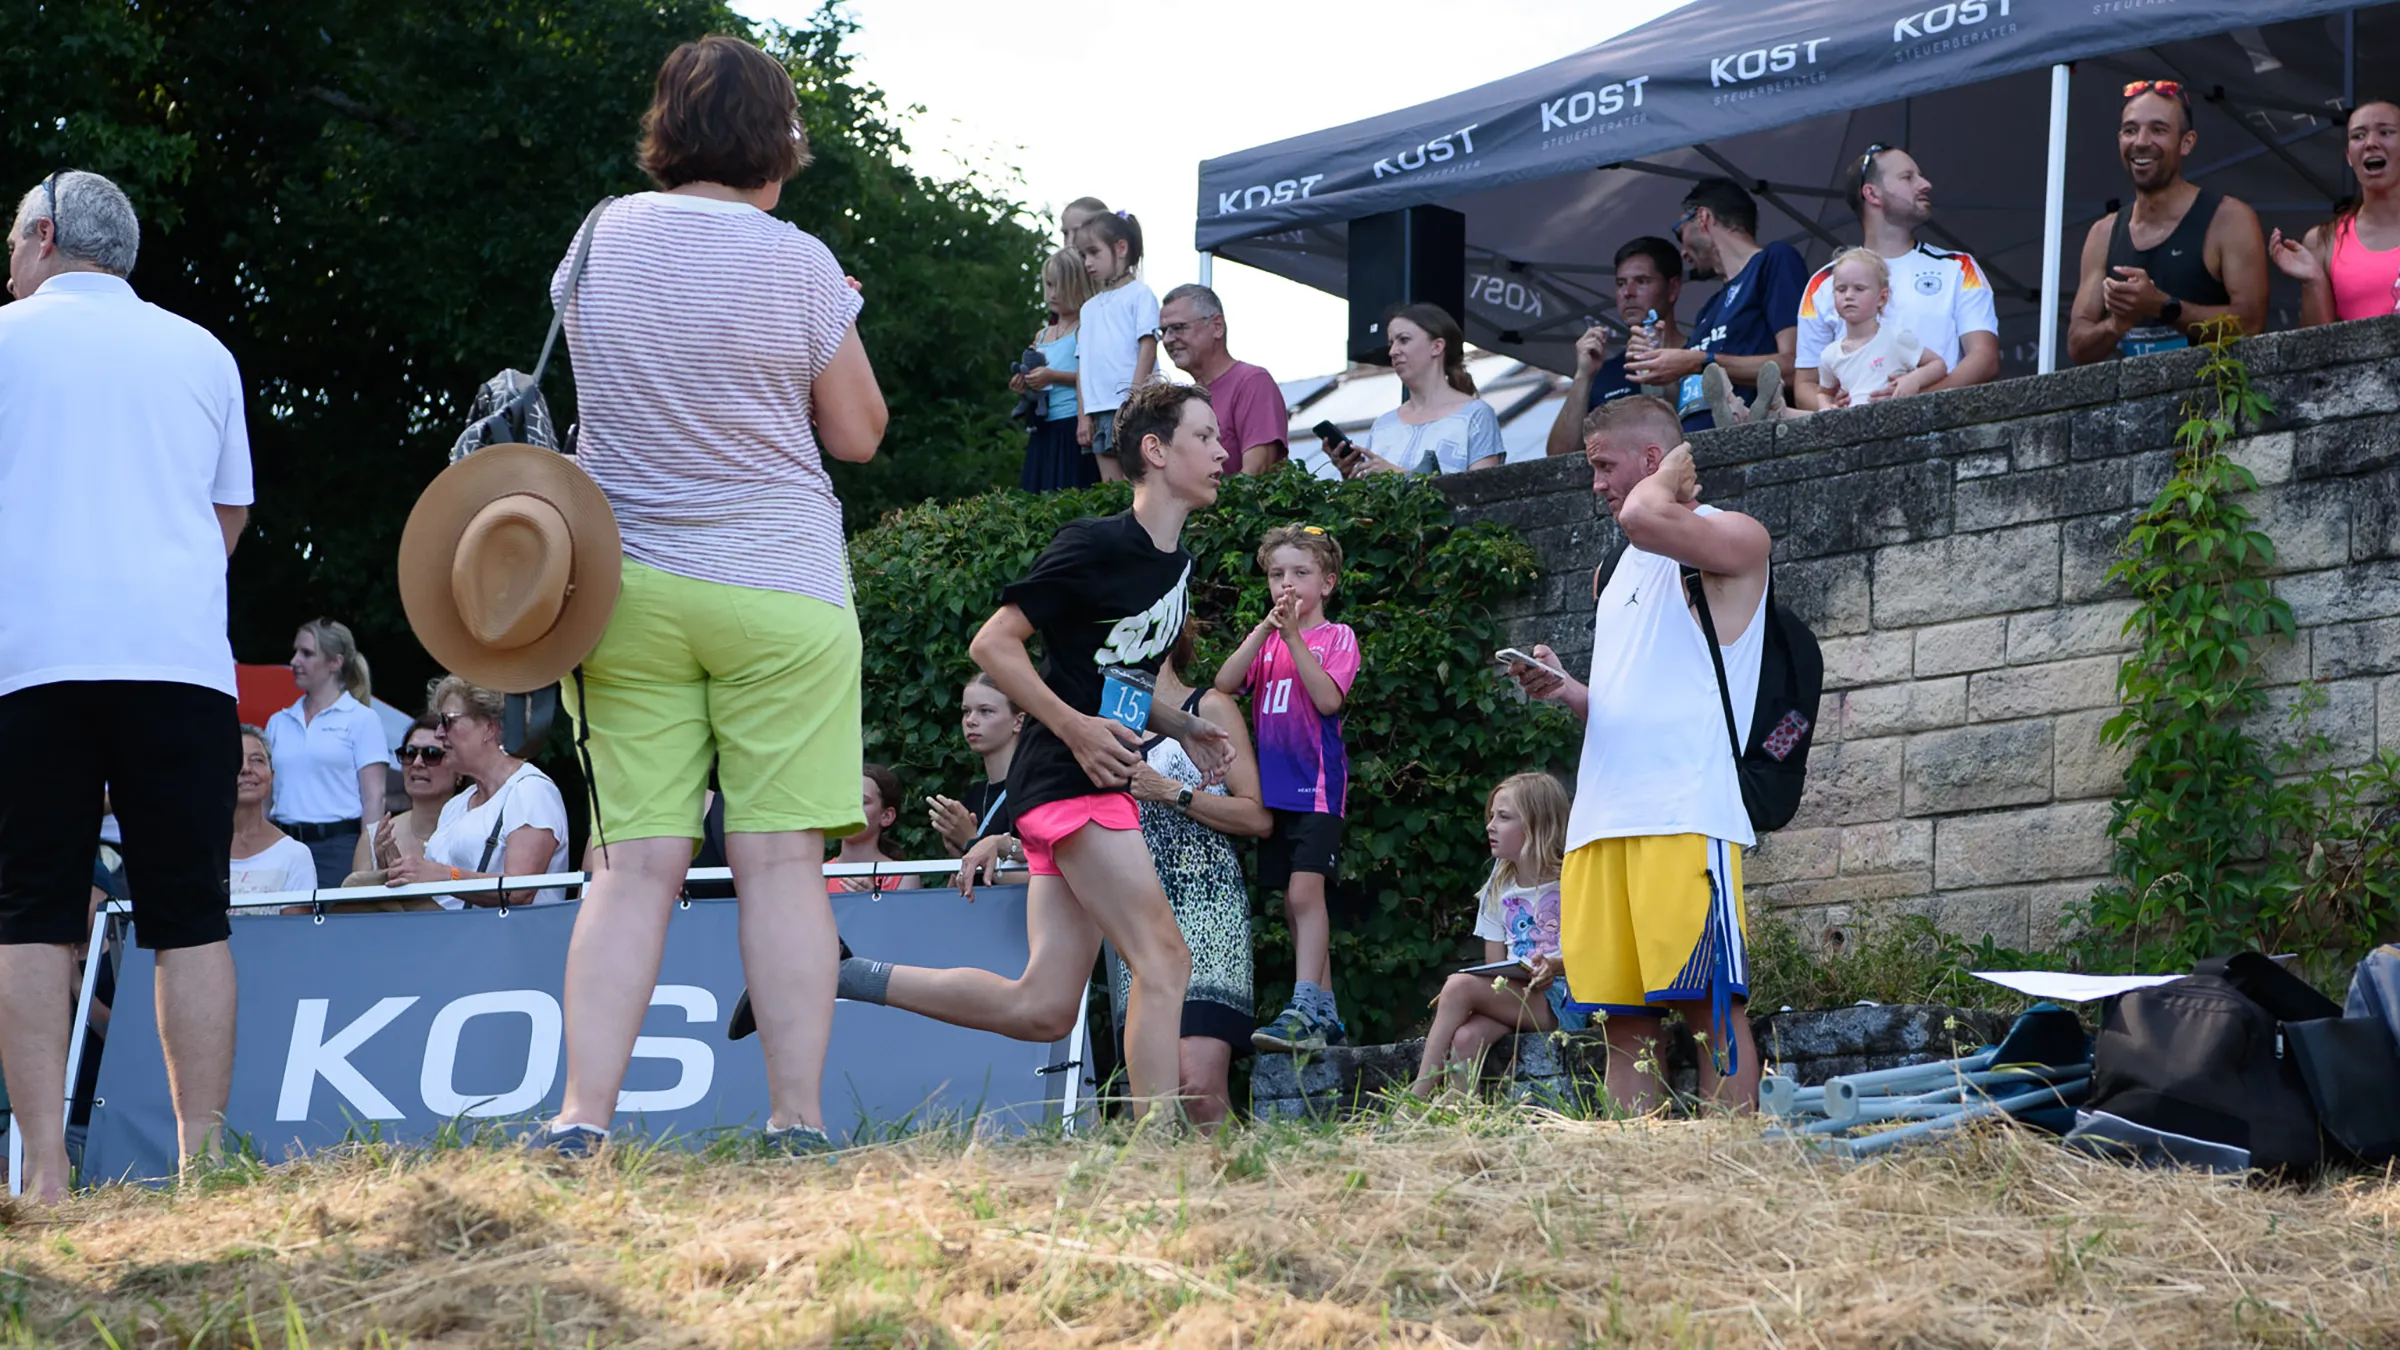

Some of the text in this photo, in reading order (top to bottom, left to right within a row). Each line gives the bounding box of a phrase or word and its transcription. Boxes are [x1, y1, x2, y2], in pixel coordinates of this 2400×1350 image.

[1711, 37, 1831, 88] KOST
[1541, 75, 1649, 133] KOST
[1542, 113, 1647, 150] STEUERBERATER
[1215, 173, 1324, 218] KOST
[1262, 678, 1293, 715] 10
[275, 983, 861, 1123] KOS
